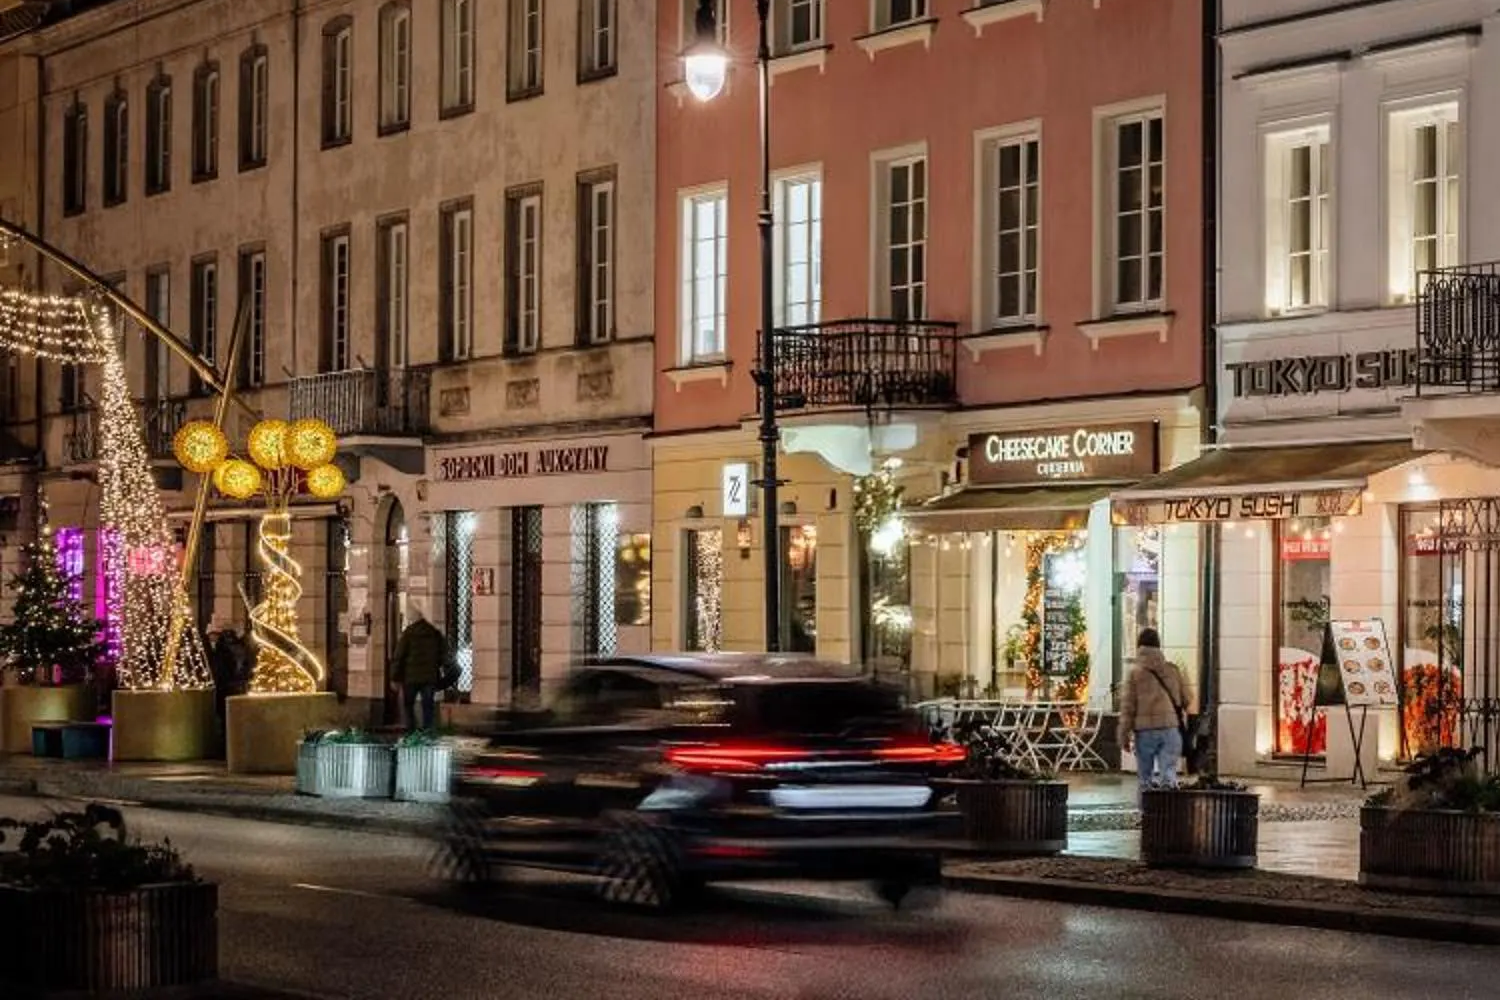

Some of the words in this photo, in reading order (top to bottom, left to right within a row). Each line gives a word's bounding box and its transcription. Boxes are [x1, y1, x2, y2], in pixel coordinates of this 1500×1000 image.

[1226, 353, 1348, 397] TOKYO
[986, 435, 1070, 462] CHEESECAKE
[1073, 428, 1134, 457] CORNER
[440, 453, 495, 480] SOPOCKI
[500, 452, 529, 476] DOM
[536, 445, 608, 473] AUKCYJNY
[1164, 497, 1232, 520] TOKYO
[1239, 494, 1300, 518] SUSHI
